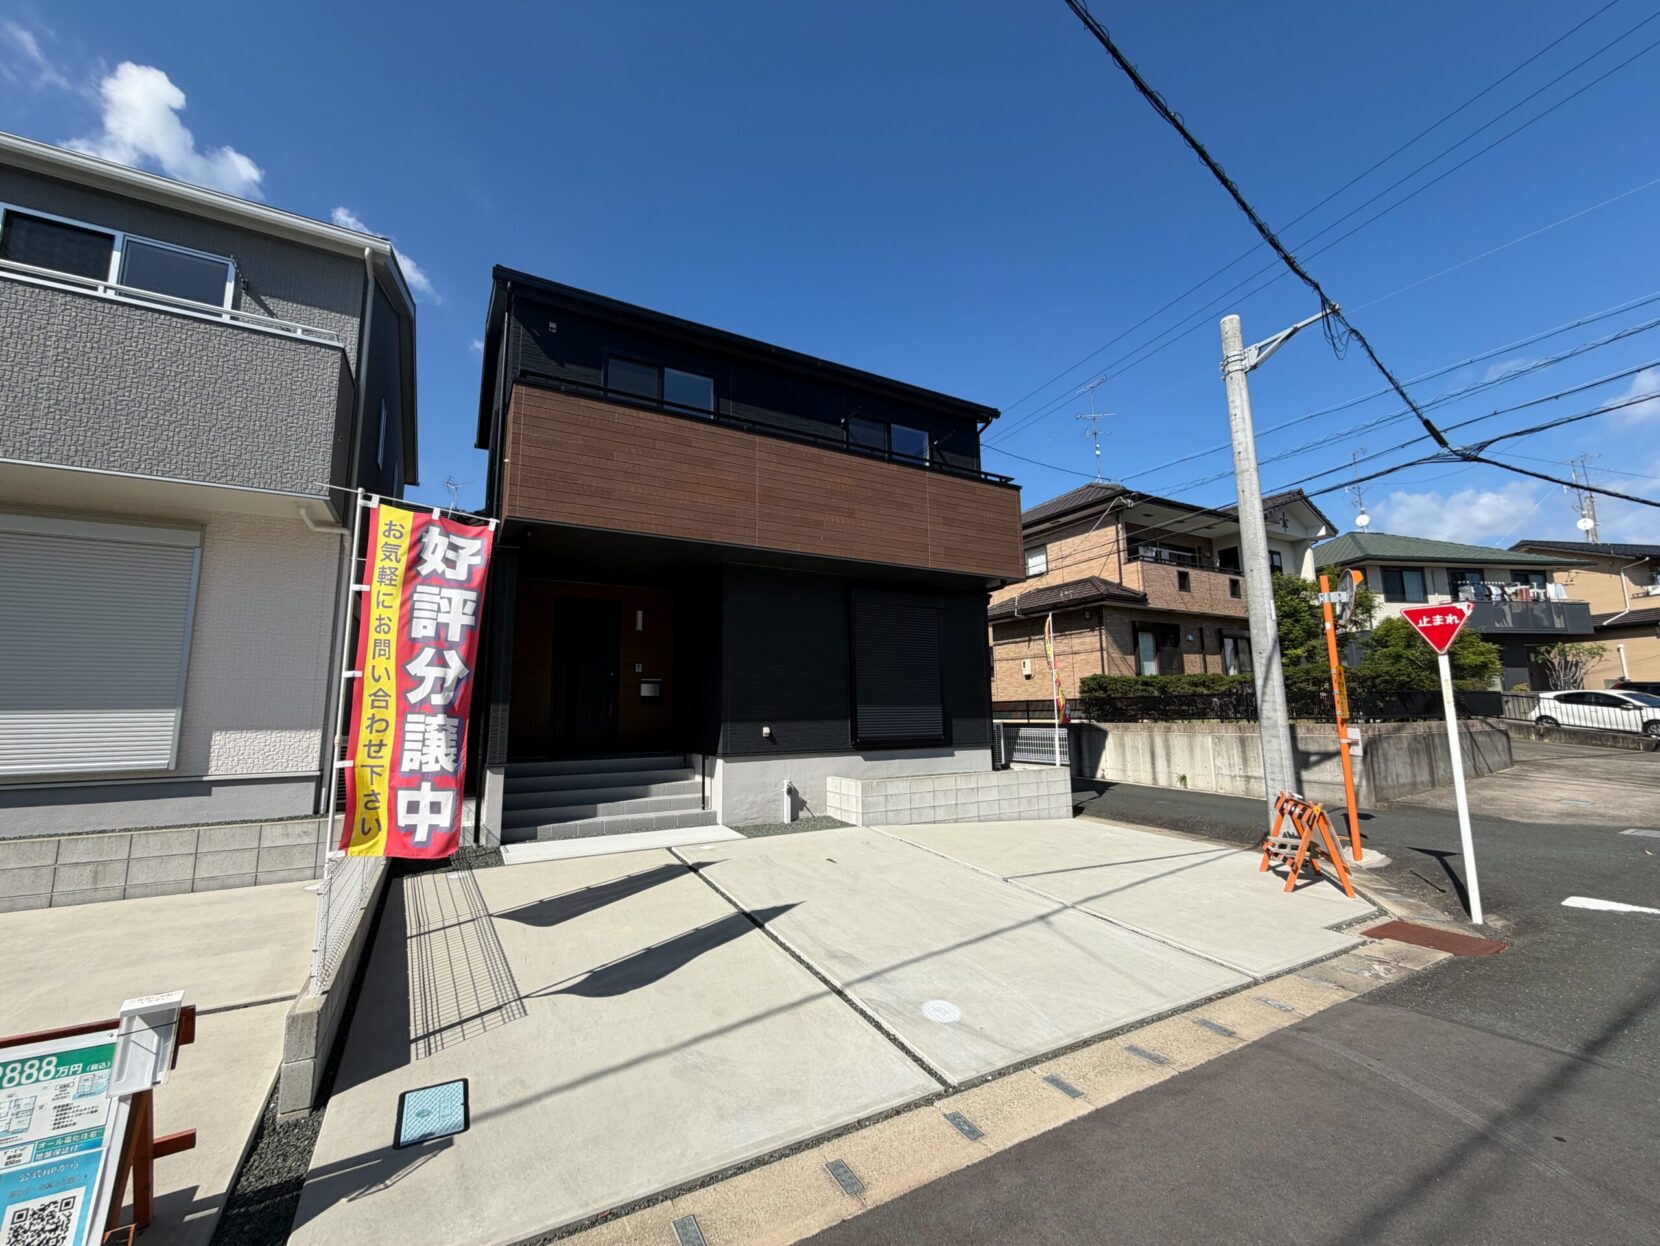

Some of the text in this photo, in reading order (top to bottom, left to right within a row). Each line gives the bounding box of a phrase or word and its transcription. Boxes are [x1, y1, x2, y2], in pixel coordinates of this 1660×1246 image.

[360, 519, 405, 837] お気軽にお問い合わせ下さい
[396, 525, 483, 843] 好評分譲中
[1417, 613, 1460, 627] 止まれ
[0, 1056, 83, 1088] 888万円
